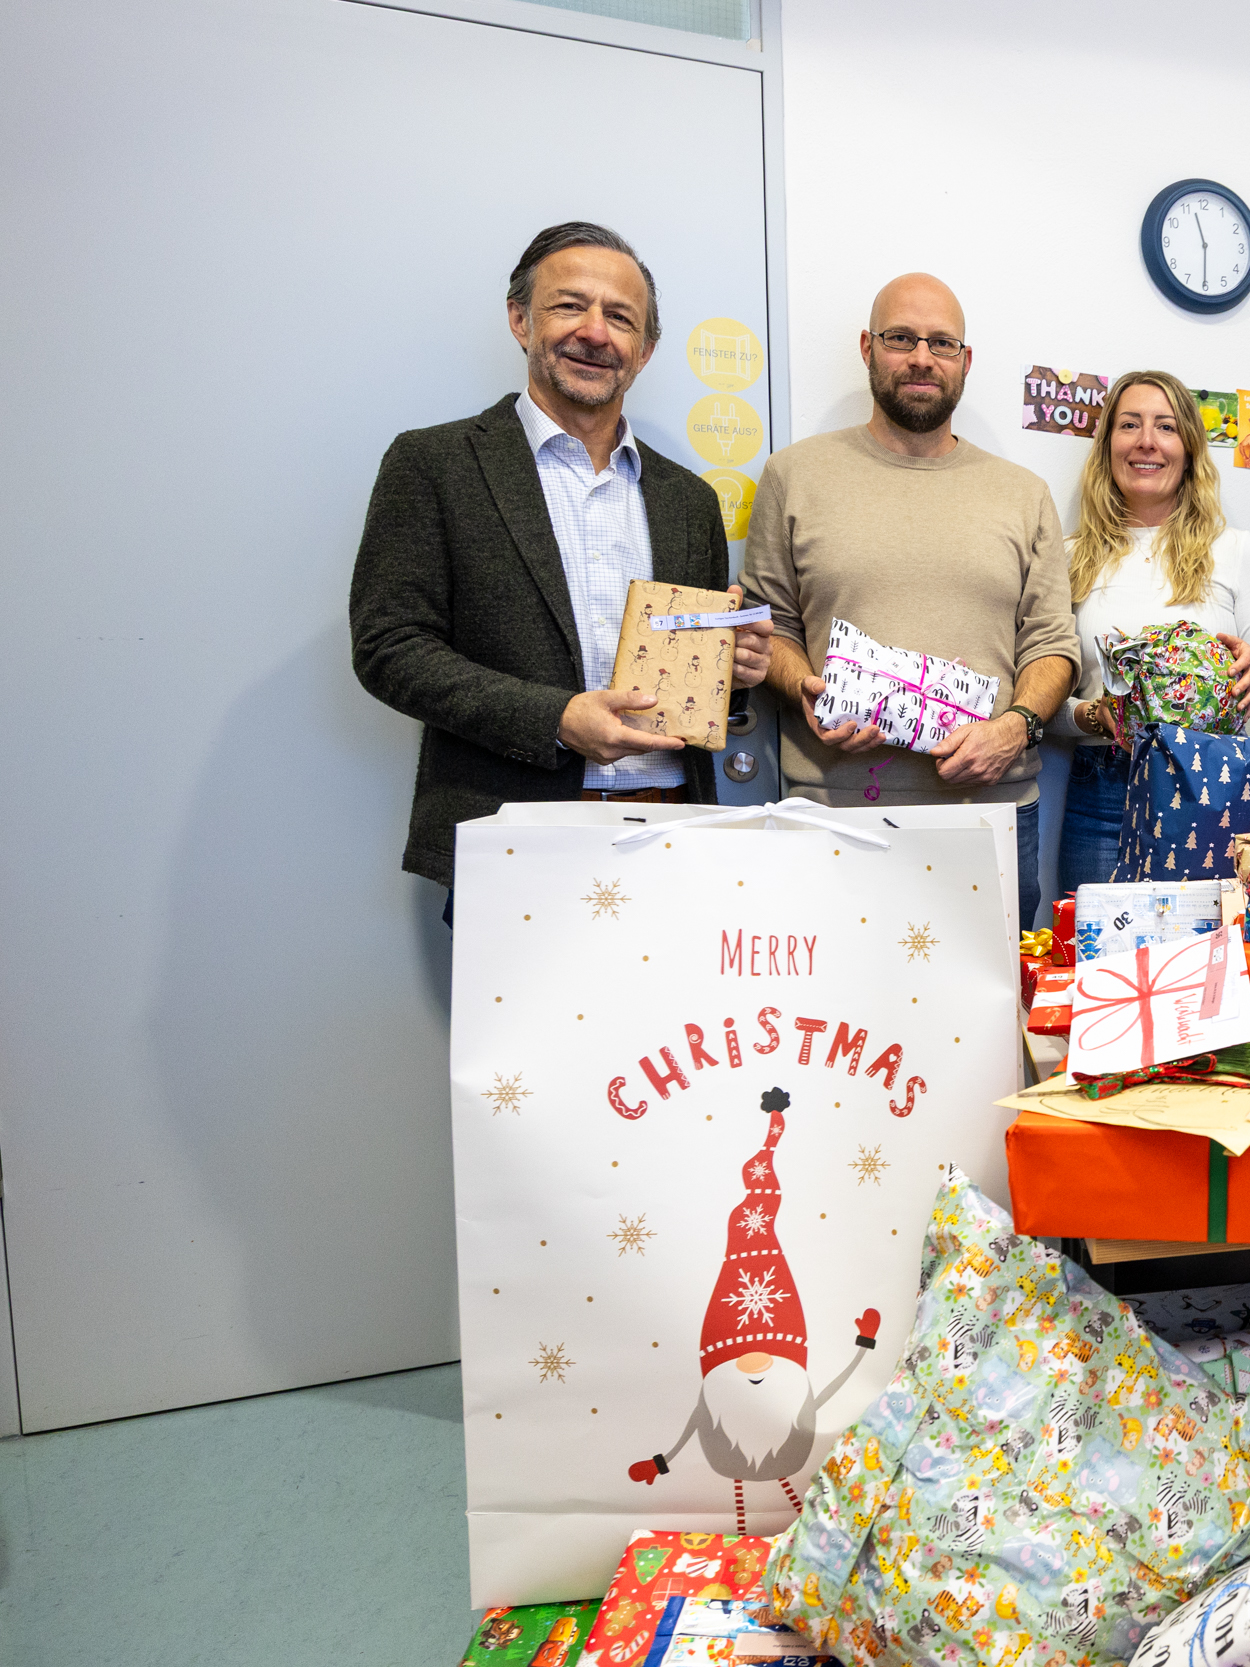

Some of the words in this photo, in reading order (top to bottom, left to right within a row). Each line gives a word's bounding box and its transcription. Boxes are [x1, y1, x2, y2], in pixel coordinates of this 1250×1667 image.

[1180, 203, 1191, 214] 11
[1198, 199, 1209, 211] 12
[1220, 207, 1225, 218] 1
[1168, 217, 1179, 229] 10
[1232, 223, 1240, 235] 2
[1163, 236, 1170, 248] 9
[1238, 243, 1245, 255] 3
[1170, 258, 1177, 270] 8
[1233, 264, 1240, 274] 4
[1184, 273, 1191, 284] 7
[1220, 276, 1228, 287] 5
[693, 348, 737, 360] FENSTER
[740, 352, 758, 362] ZU?
[1026, 377, 1106, 407] THANK
[1040, 403, 1089, 429] YOU
[693, 423, 730, 435] GERÄTE
[732, 427, 758, 436] AUS?
[729, 501, 754, 510] AUS?
[1113, 911, 1134, 932] 30
[720, 928, 818, 977] MERRY
